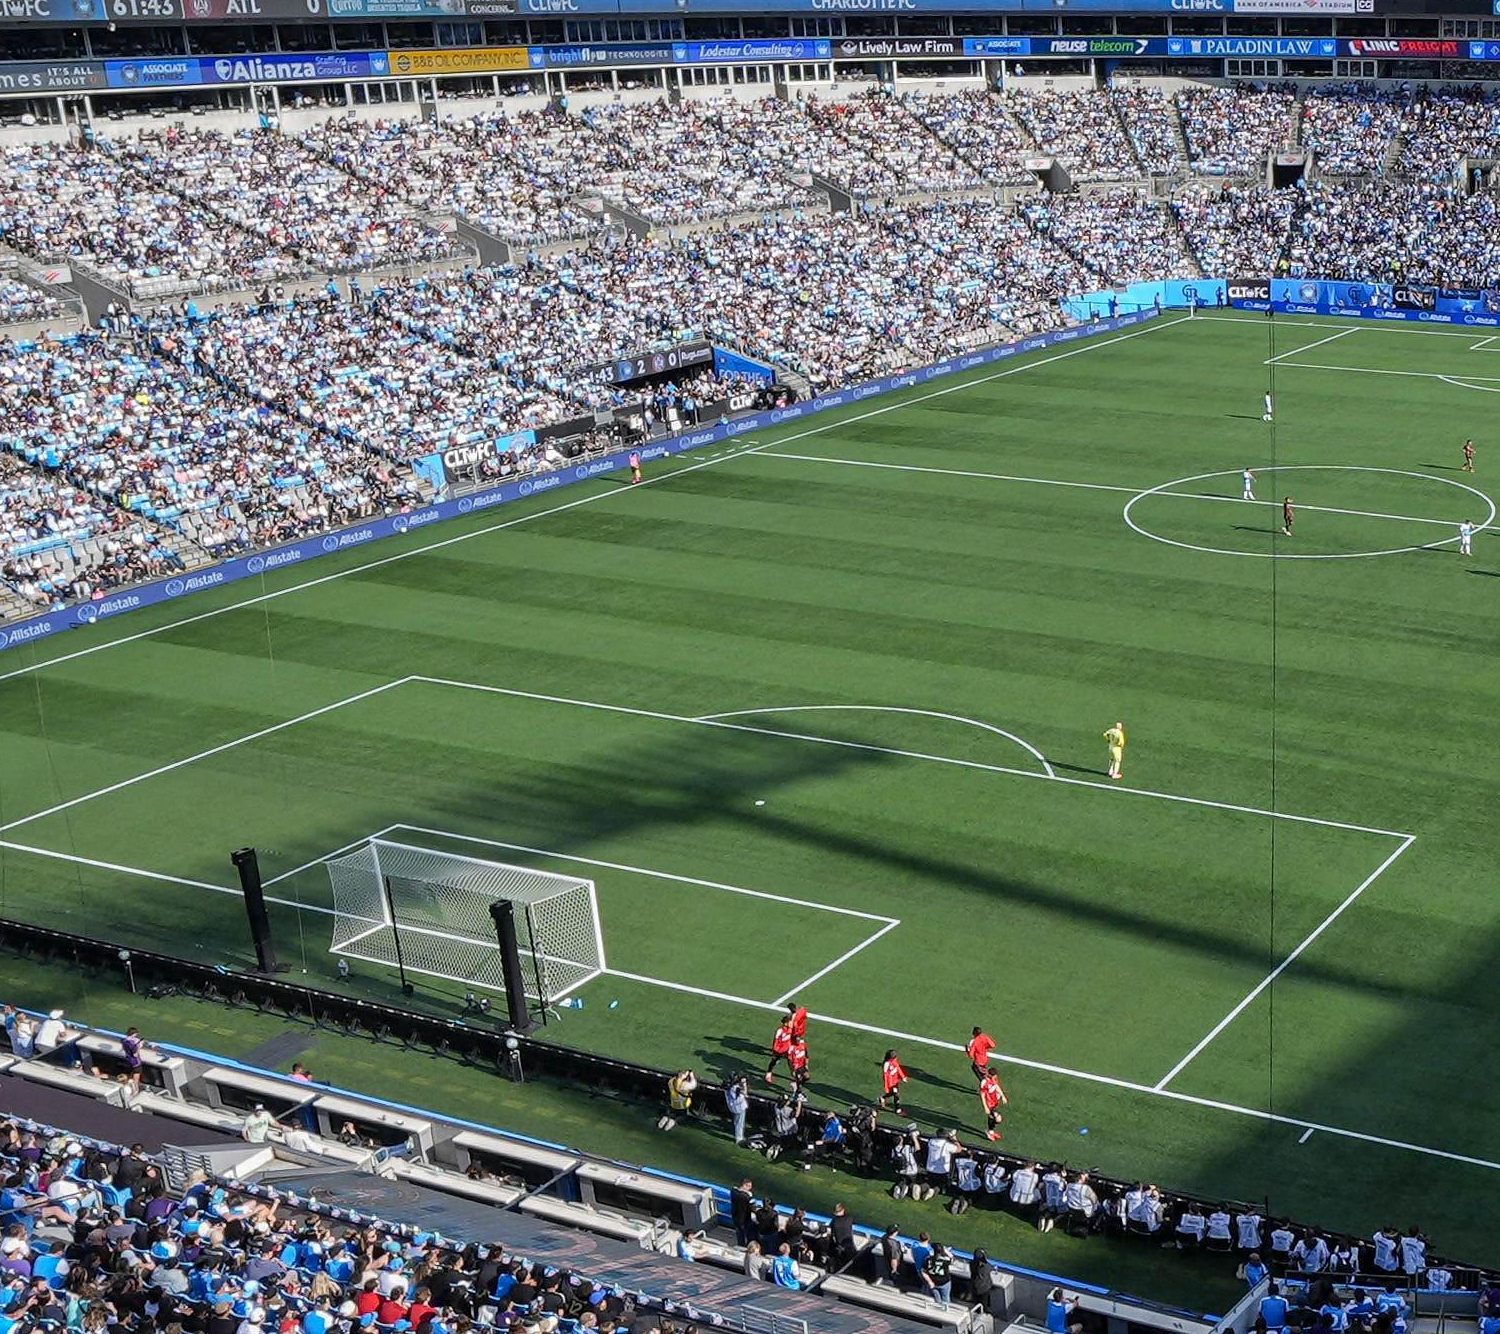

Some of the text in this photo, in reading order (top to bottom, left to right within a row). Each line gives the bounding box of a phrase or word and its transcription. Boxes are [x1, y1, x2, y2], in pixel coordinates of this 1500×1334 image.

[607, 49, 669, 60] TECHNOLOGIES
[699, 42, 792, 58] Lodestar Consulting
[858, 40, 955, 56] Lively Law Firm
[1050, 40, 1134, 53] neuse telecom
[1207, 40, 1313, 54] PALADIN LAW
[141, 64, 188, 75] ASSOCIATE
[233, 58, 316, 82] Alianza
[412, 55, 435, 68] B&B
[47, 65, 94, 77] IT'S ALL
[49, 76, 86, 87] ABOUT
[533, 474, 560, 494] Allstate
[471, 493, 503, 511] Allstate
[407, 508, 441, 527] Allstate
[339, 527, 374, 549] Allstate
[263, 548, 302, 570] Allstate
[183, 570, 224, 593] Allstate
[97, 591, 141, 618] Allstate
[8, 619, 53, 646] Allstate
